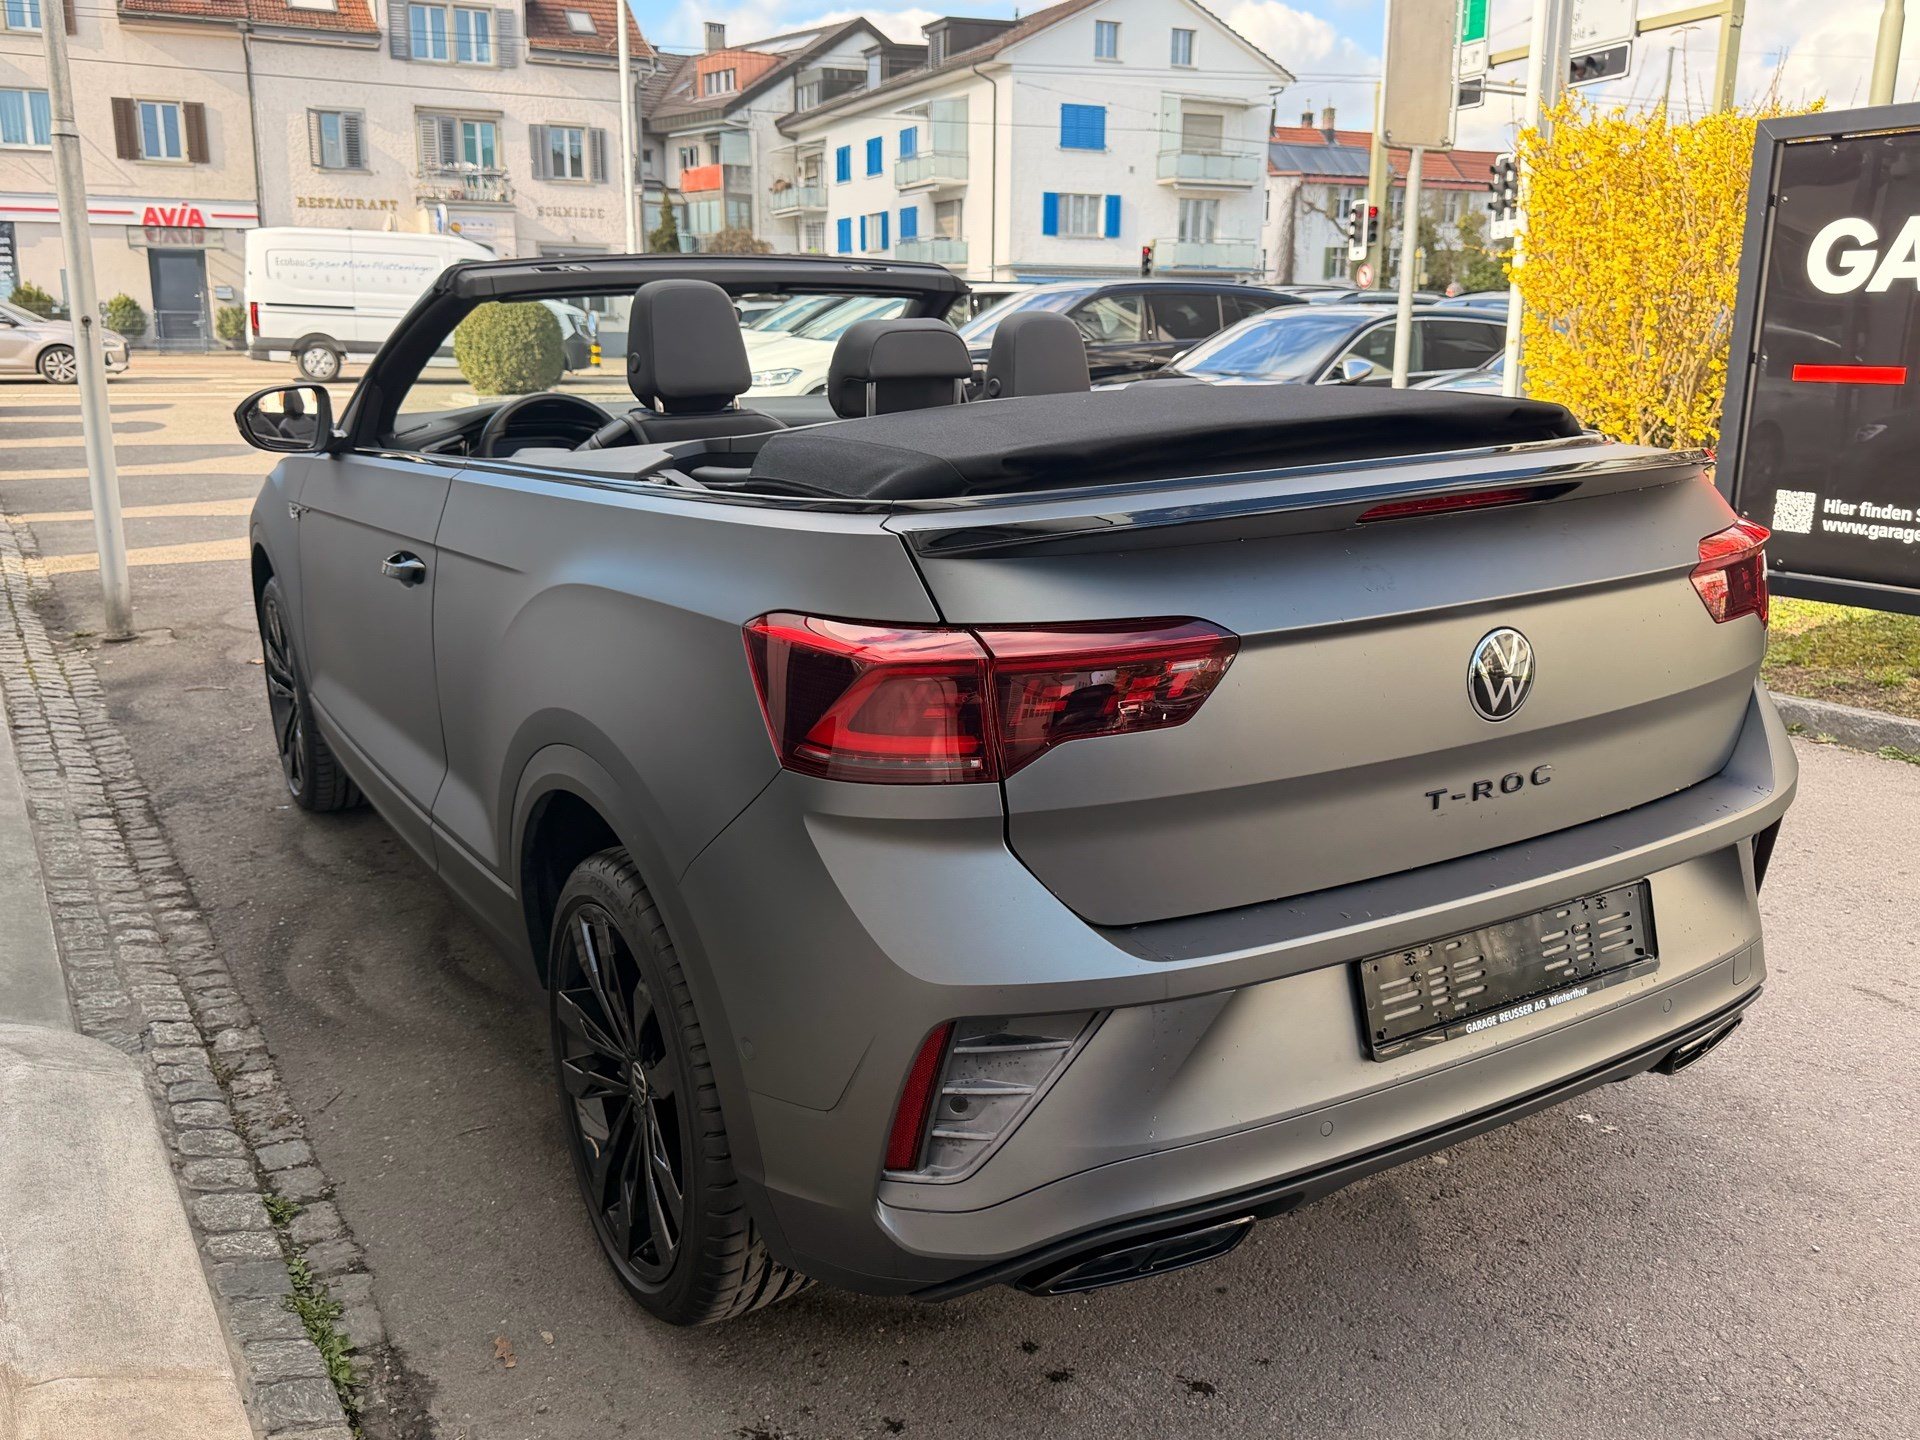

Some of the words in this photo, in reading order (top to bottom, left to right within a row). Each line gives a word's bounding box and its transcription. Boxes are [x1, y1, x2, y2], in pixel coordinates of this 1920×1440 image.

[141, 202, 206, 228] AVIA
[297, 196, 399, 211] RESTAURANT
[536, 206, 606, 219] SCHMIEDE
[1823, 498, 1858, 516] Hier
[1859, 501, 1912, 522] finden
[1822, 519, 1920, 544] www.garage
[1425, 764, 1553, 811] T-ROC
[1465, 1015, 1498, 1034] GARAGE
[1499, 1003, 1533, 1023] REUSSER
[1534, 999, 1547, 1012] AG
[1548, 987, 1588, 1007] Winterthur
